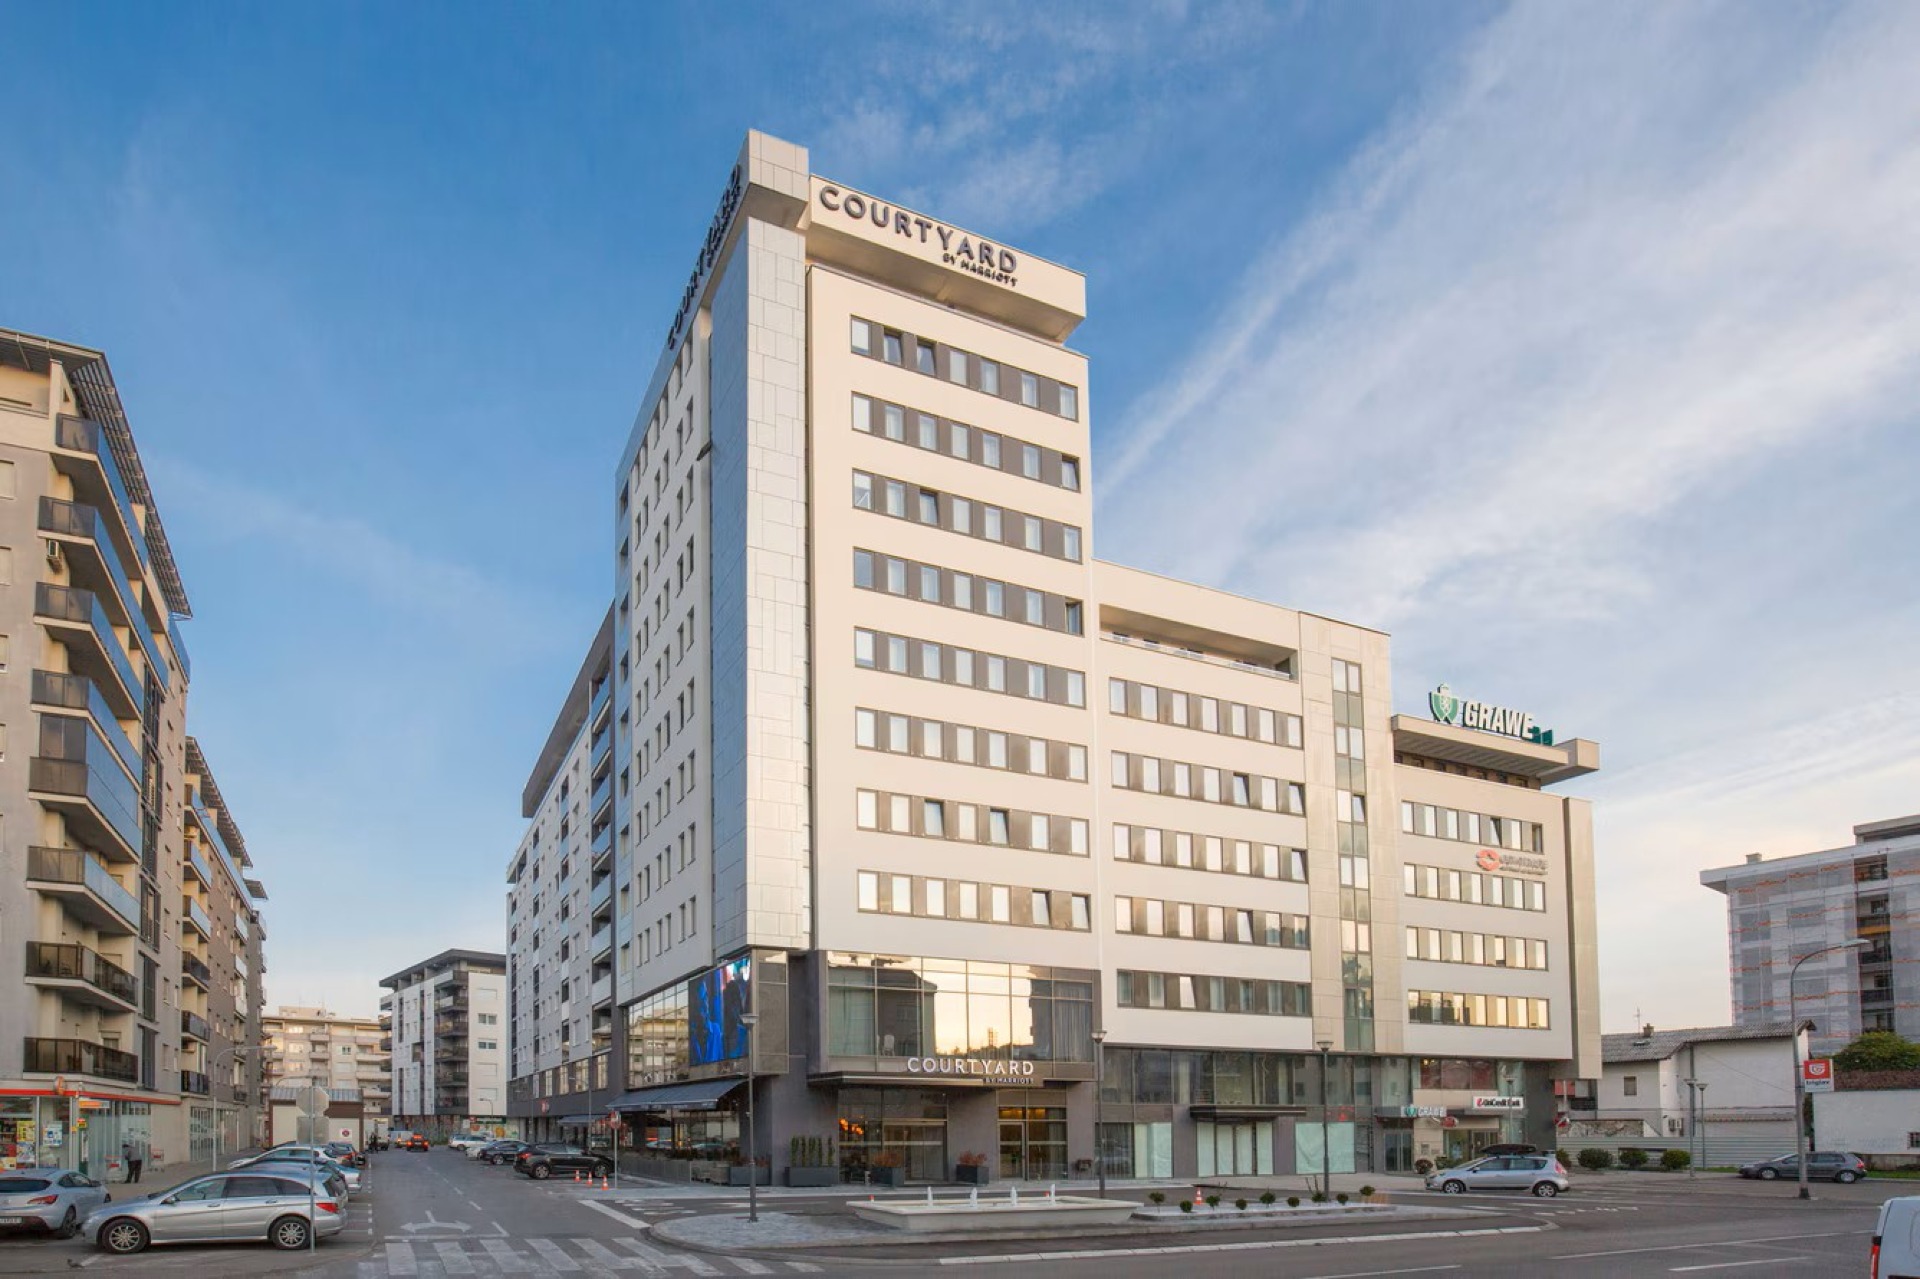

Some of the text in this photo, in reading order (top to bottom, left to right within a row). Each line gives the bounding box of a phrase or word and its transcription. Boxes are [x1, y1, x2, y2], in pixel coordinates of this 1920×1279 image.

[819, 185, 1017, 274] COURTYARD
[943, 252, 1018, 287] BY MARRIOTT
[1464, 701, 1536, 739] GRAWE
[907, 1057, 1034, 1075] COURTYARD
